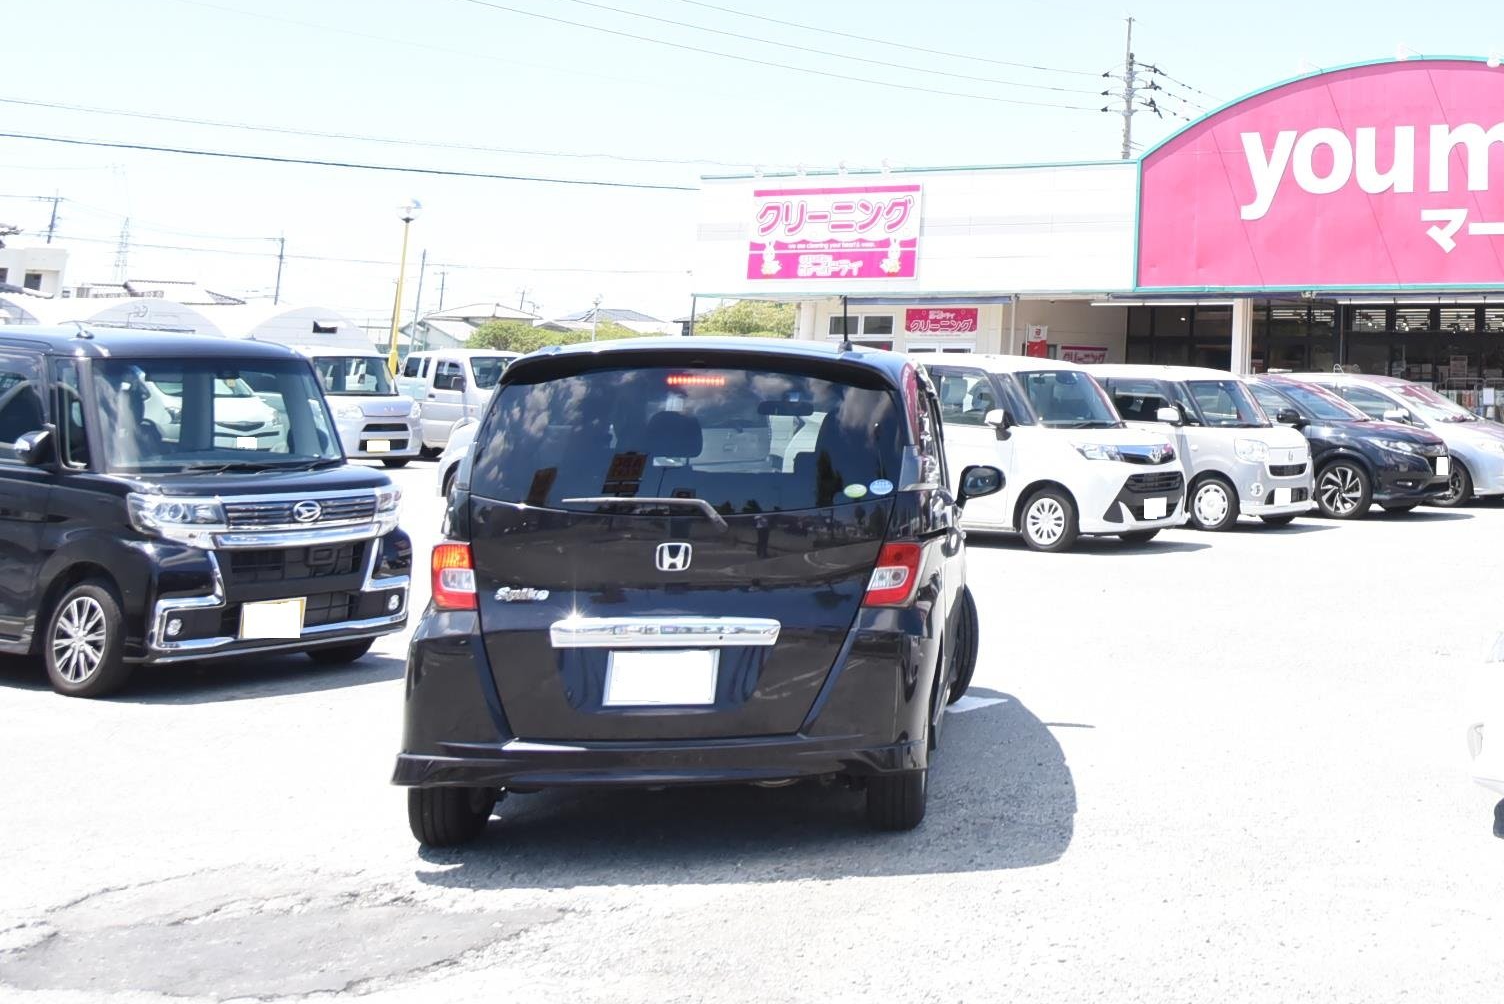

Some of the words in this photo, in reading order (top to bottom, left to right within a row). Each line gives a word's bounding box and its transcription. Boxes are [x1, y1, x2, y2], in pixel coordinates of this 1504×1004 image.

[757, 195, 915, 236] クリーニング
[910, 318, 973, 332] クリーニング
[494, 586, 550, 601] Spike
